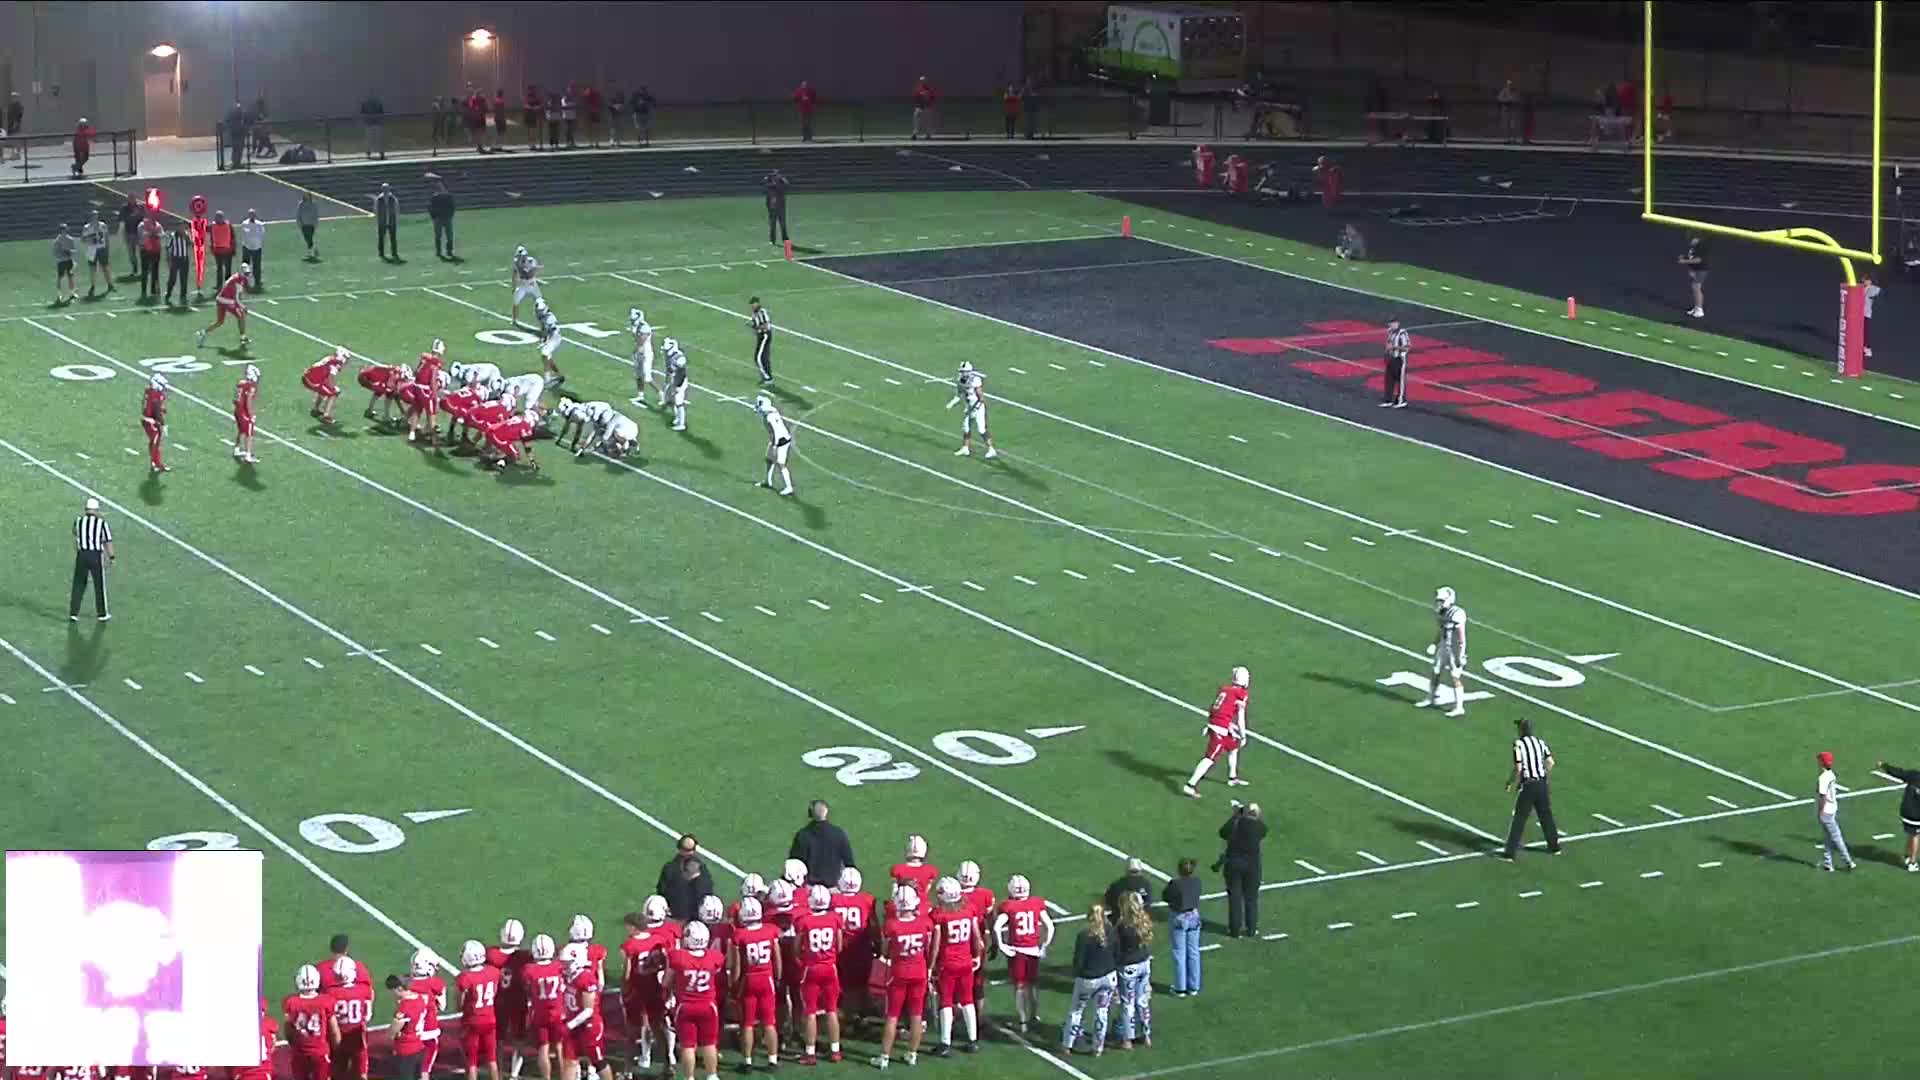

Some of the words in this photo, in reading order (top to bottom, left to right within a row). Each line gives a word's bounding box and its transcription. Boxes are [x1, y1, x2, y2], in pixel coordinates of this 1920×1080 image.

[1208, 320, 1920, 516] TIGERS
[1376, 656, 1586, 706] 10
[801, 729, 1038, 787] 20
[834, 906, 861, 930] 79
[1015, 911, 1036, 935] 31
[808, 927, 834, 952] 89
[947, 918, 971, 943] 58
[746, 940, 771, 964] 85
[898, 933, 923, 956] 75
[538, 976, 560, 1000] 17
[684, 969, 711, 992] 72
[475, 981, 496, 1008] 14
[334, 999, 361, 1023] 20
